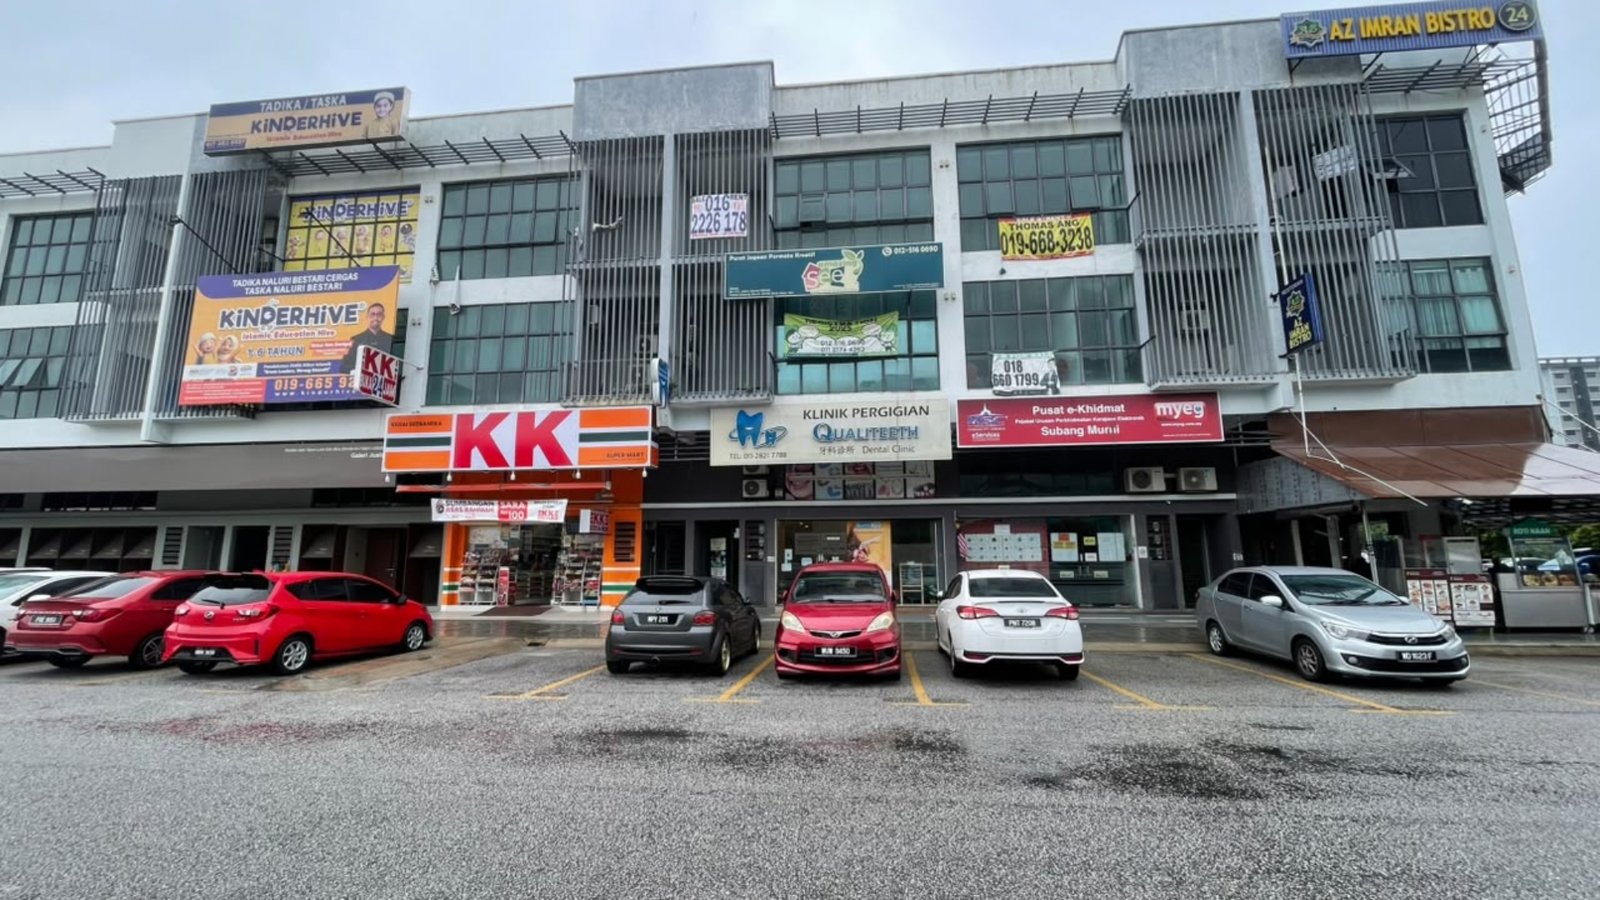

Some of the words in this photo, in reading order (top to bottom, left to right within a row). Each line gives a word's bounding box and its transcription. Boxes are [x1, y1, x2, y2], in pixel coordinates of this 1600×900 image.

[1506, 6, 1528, 22] 24
[1330, 21, 1355, 41] AZ
[1360, 15, 1421, 38] IMRAN
[1426, 7, 1496, 33] BISTRO
[260, 102, 301, 113] TADIKA
[311, 95, 347, 107] TASKA
[705, 195, 730, 212] 016
[692, 212, 721, 233] 2226
[724, 211, 746, 232] 178
[1009, 221, 1054, 231] THOMAS
[1057, 219, 1080, 228] ANG
[232, 279, 261, 288] TADIKA
[261, 277, 292, 286] NALURI
[292, 274, 325, 284] BESTARI
[325, 272, 359, 282] CERGAS
[245, 286, 272, 296] TASKA
[273, 283, 306, 294] NALURI
[306, 282, 343, 292] BESTARI
[274, 329, 316, 338] Education
[267, 346, 304, 357] TAHUN
[363, 346, 395, 380] KK
[1003, 360, 1024, 373] 018
[274, 376, 334, 391] 019-665
[1013, 372, 1039, 386] 1799
[803, 408, 847, 420] KLINIK
[852, 405, 930, 418] PERGIGIAN
[1032, 405, 1065, 415] Pusat
[1067, 403, 1126, 414] e-Khidmat
[1155, 402, 1205, 419] myeg
[453, 409, 574, 468] KK
[1041, 425, 1085, 437] Subang
[862, 445, 889, 454] Dental
[891, 444, 916, 453] Clinic
